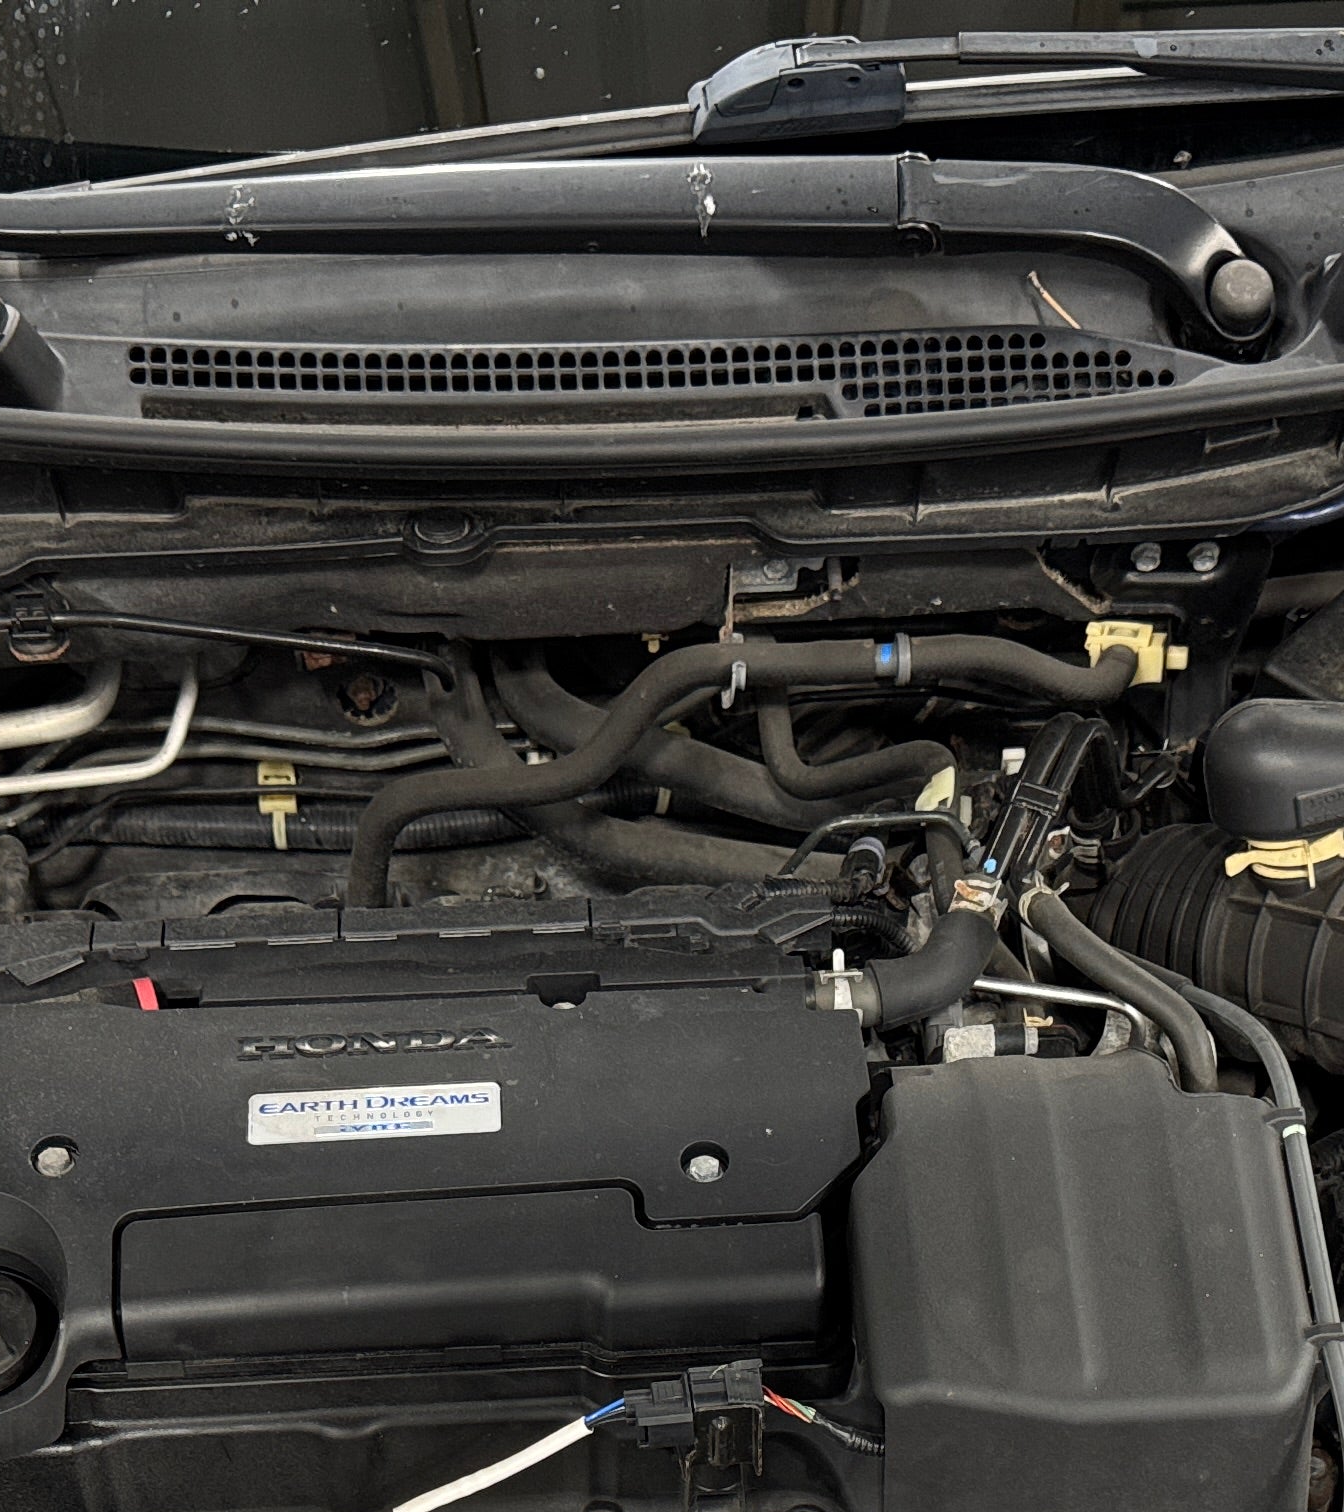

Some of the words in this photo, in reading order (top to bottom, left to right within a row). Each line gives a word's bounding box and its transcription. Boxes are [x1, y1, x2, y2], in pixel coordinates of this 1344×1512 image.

[237, 1027, 513, 1062] HONDA
[258, 1097, 358, 1115] EARTH
[365, 1092, 490, 1108] DREAMS
[315, 1110, 436, 1122] TECHNOLOGY
